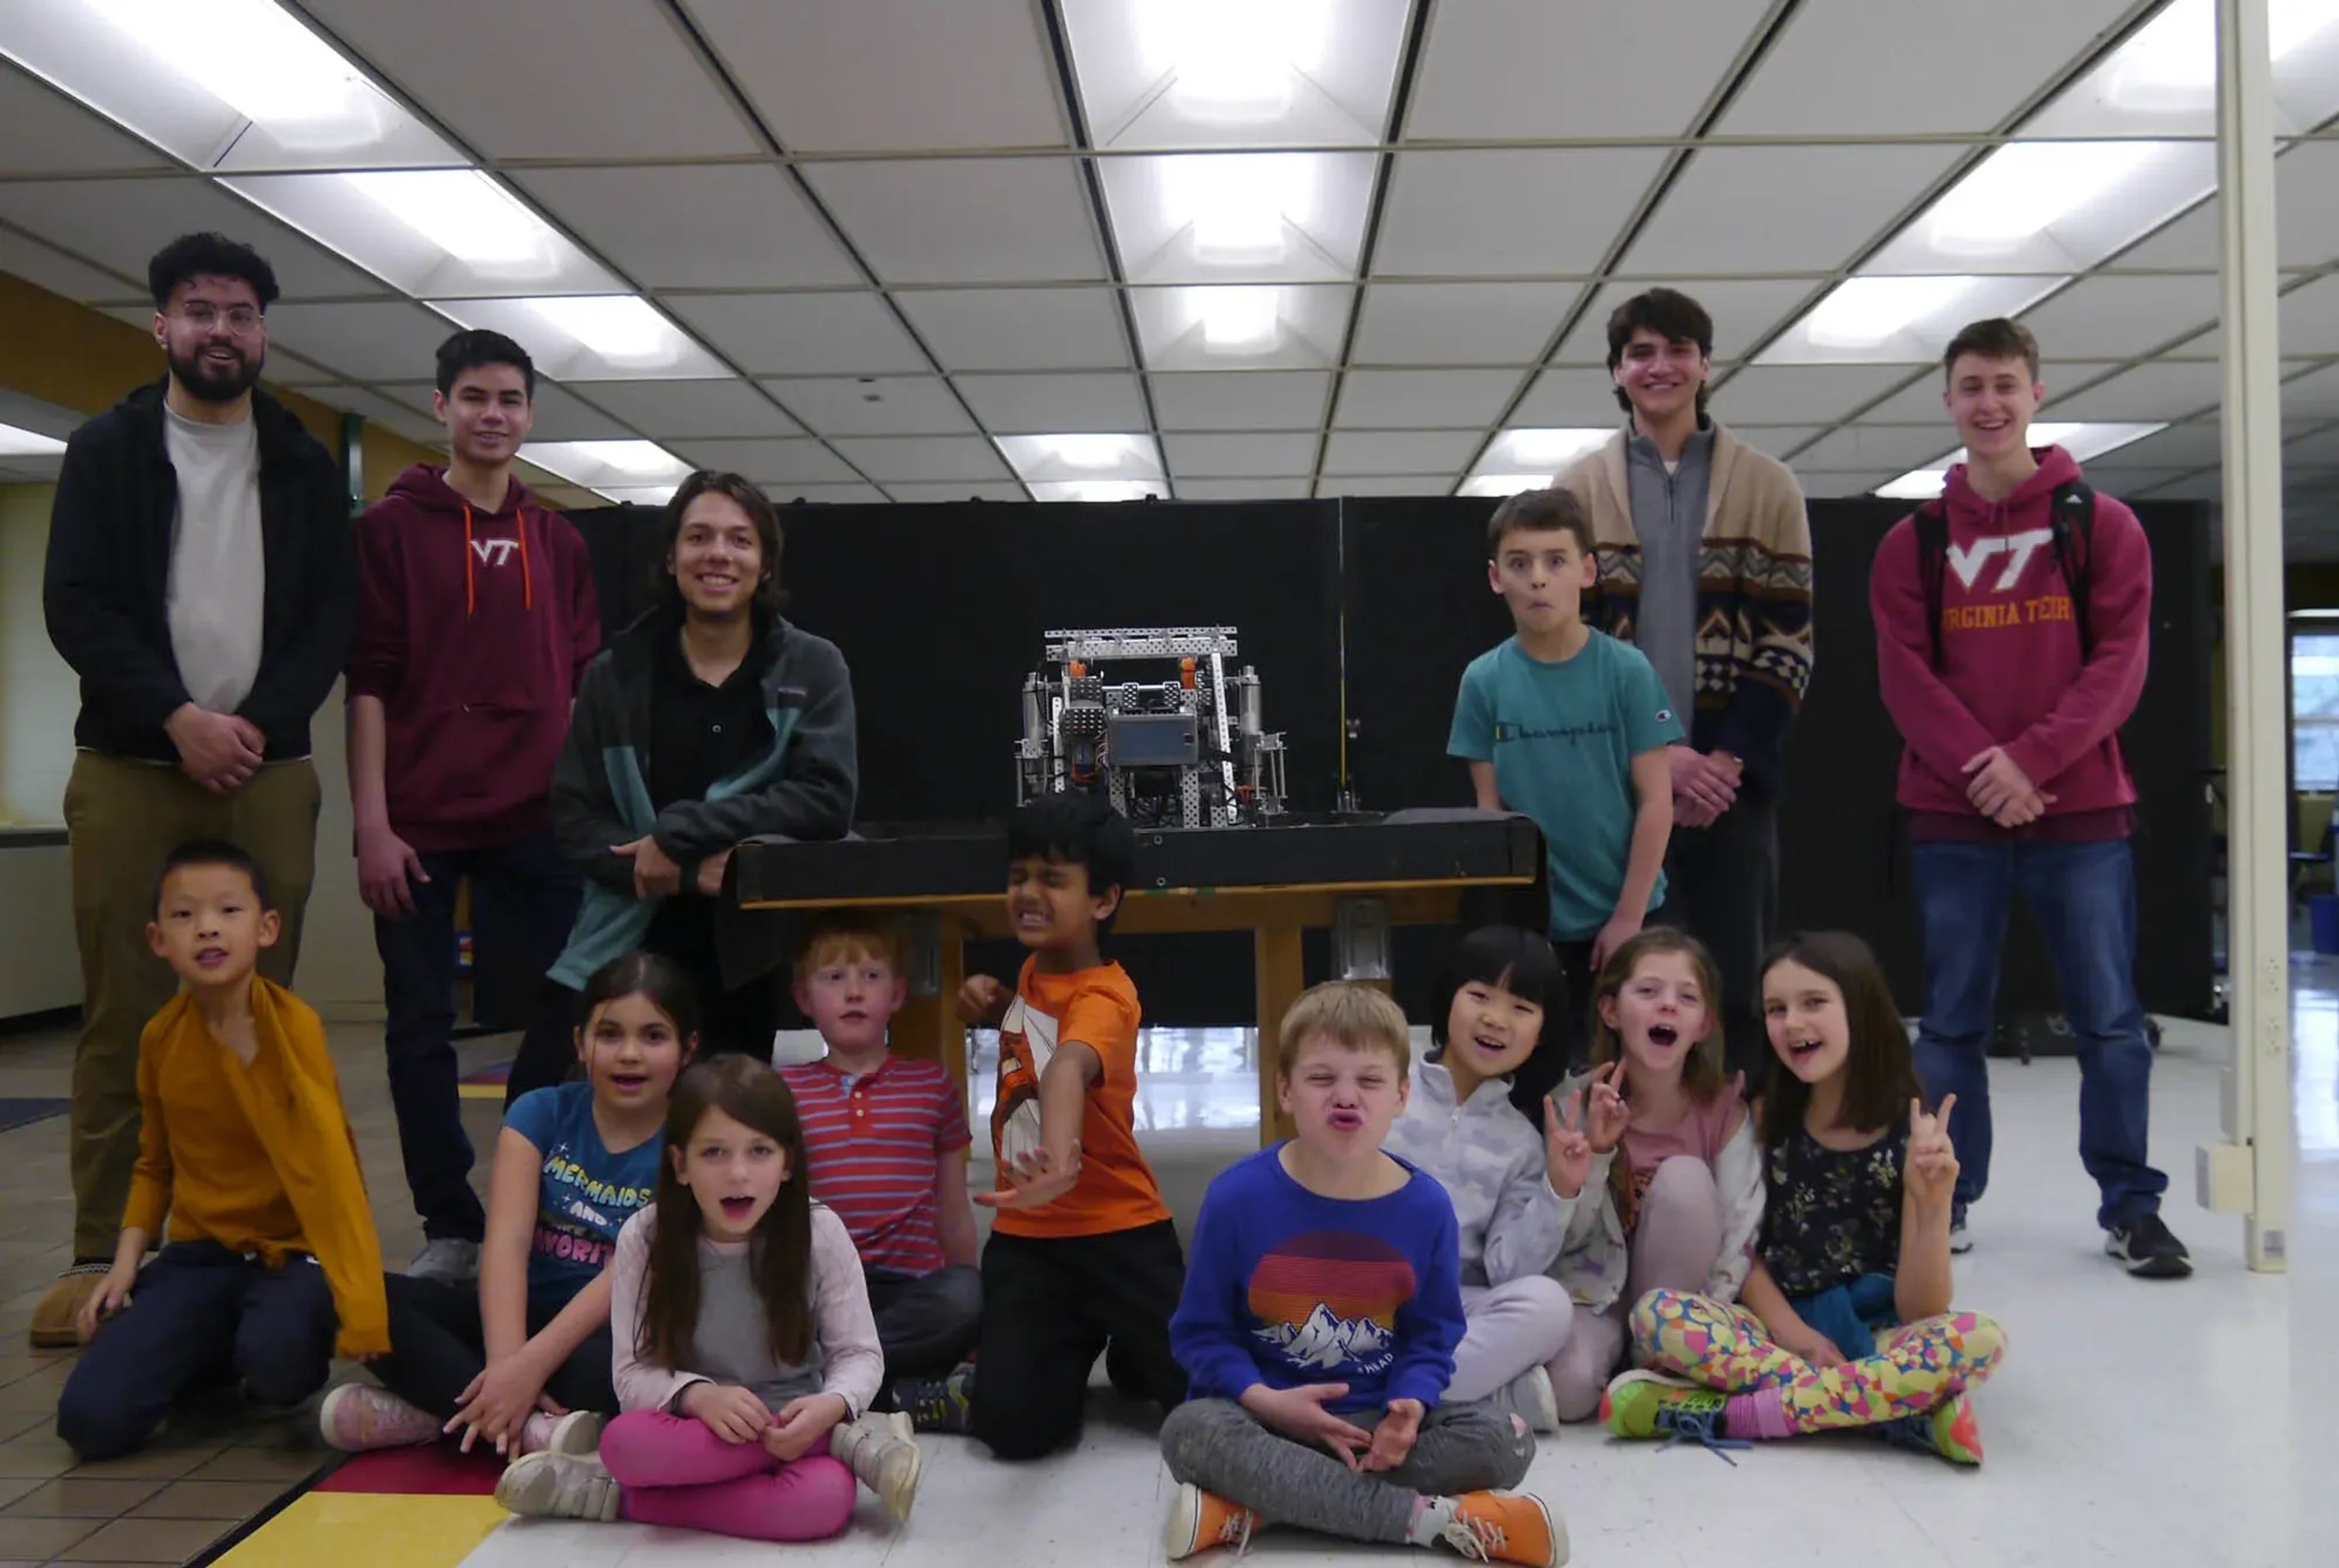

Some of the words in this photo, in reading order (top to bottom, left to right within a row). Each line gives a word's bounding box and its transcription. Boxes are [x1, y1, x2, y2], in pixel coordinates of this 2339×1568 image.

[470, 539, 519, 566] VT
[1946, 528, 2053, 592] VT
[1943, 602, 2021, 630] RGINIA
[543, 1156, 652, 1208] MERMAIDS
[570, 1200, 608, 1226] AND
